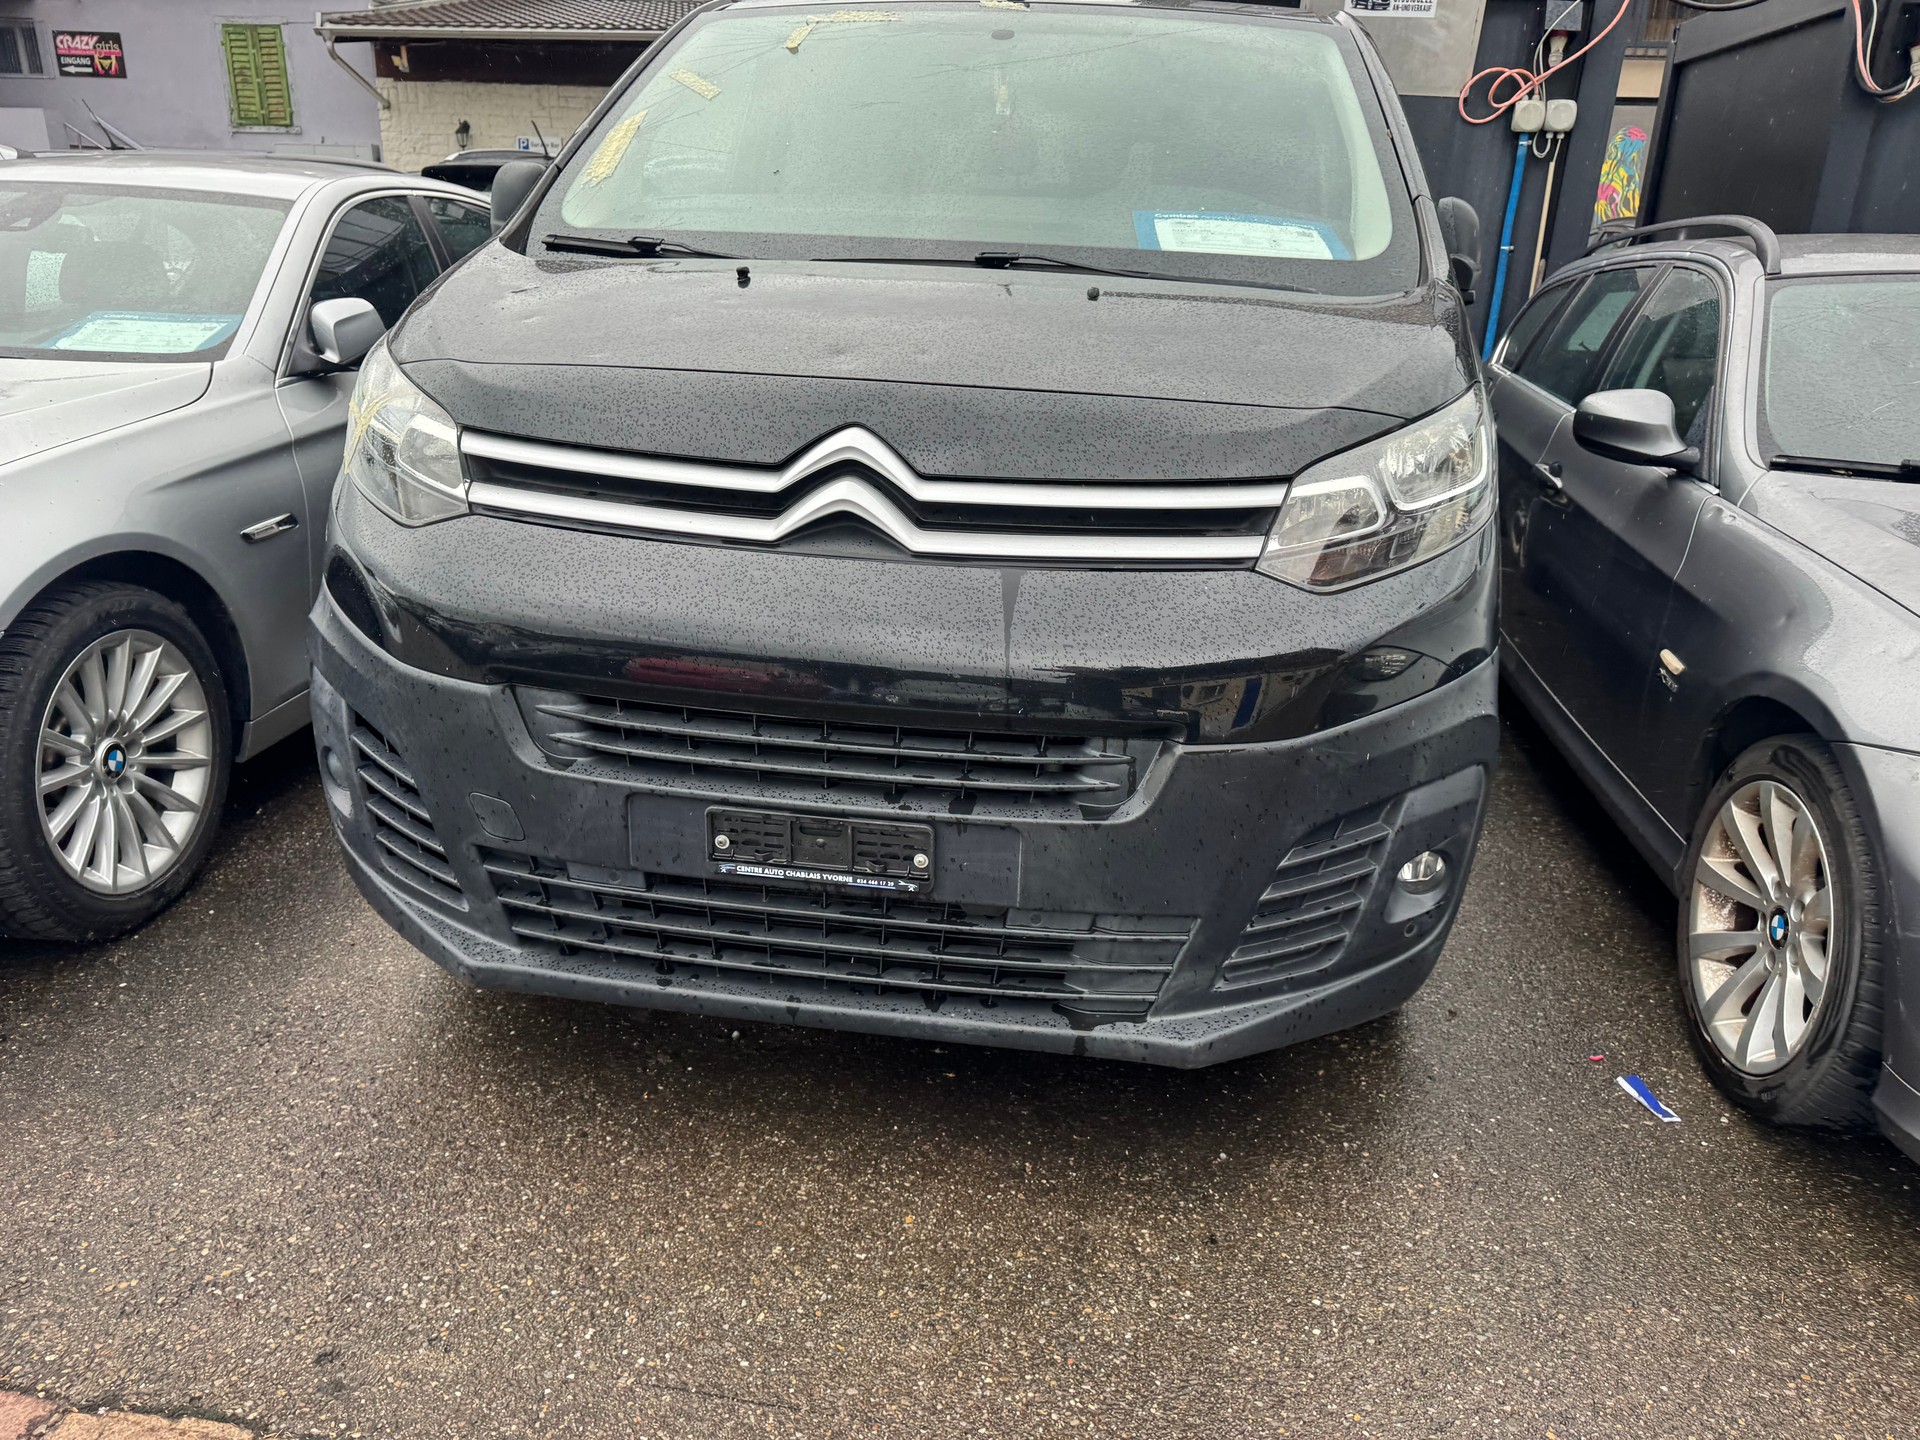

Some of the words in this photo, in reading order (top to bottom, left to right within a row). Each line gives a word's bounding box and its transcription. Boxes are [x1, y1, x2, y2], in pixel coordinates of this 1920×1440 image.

[56, 33, 99, 50] CRAZY
[95, 41, 120, 56] girls
[60, 56, 91, 65] EINGANG
[736, 865, 763, 874] CENTRE
[763, 868, 784, 876] AUTO
[785, 870, 821, 880] CHABLAIS
[822, 873, 853, 883] YVORNE
